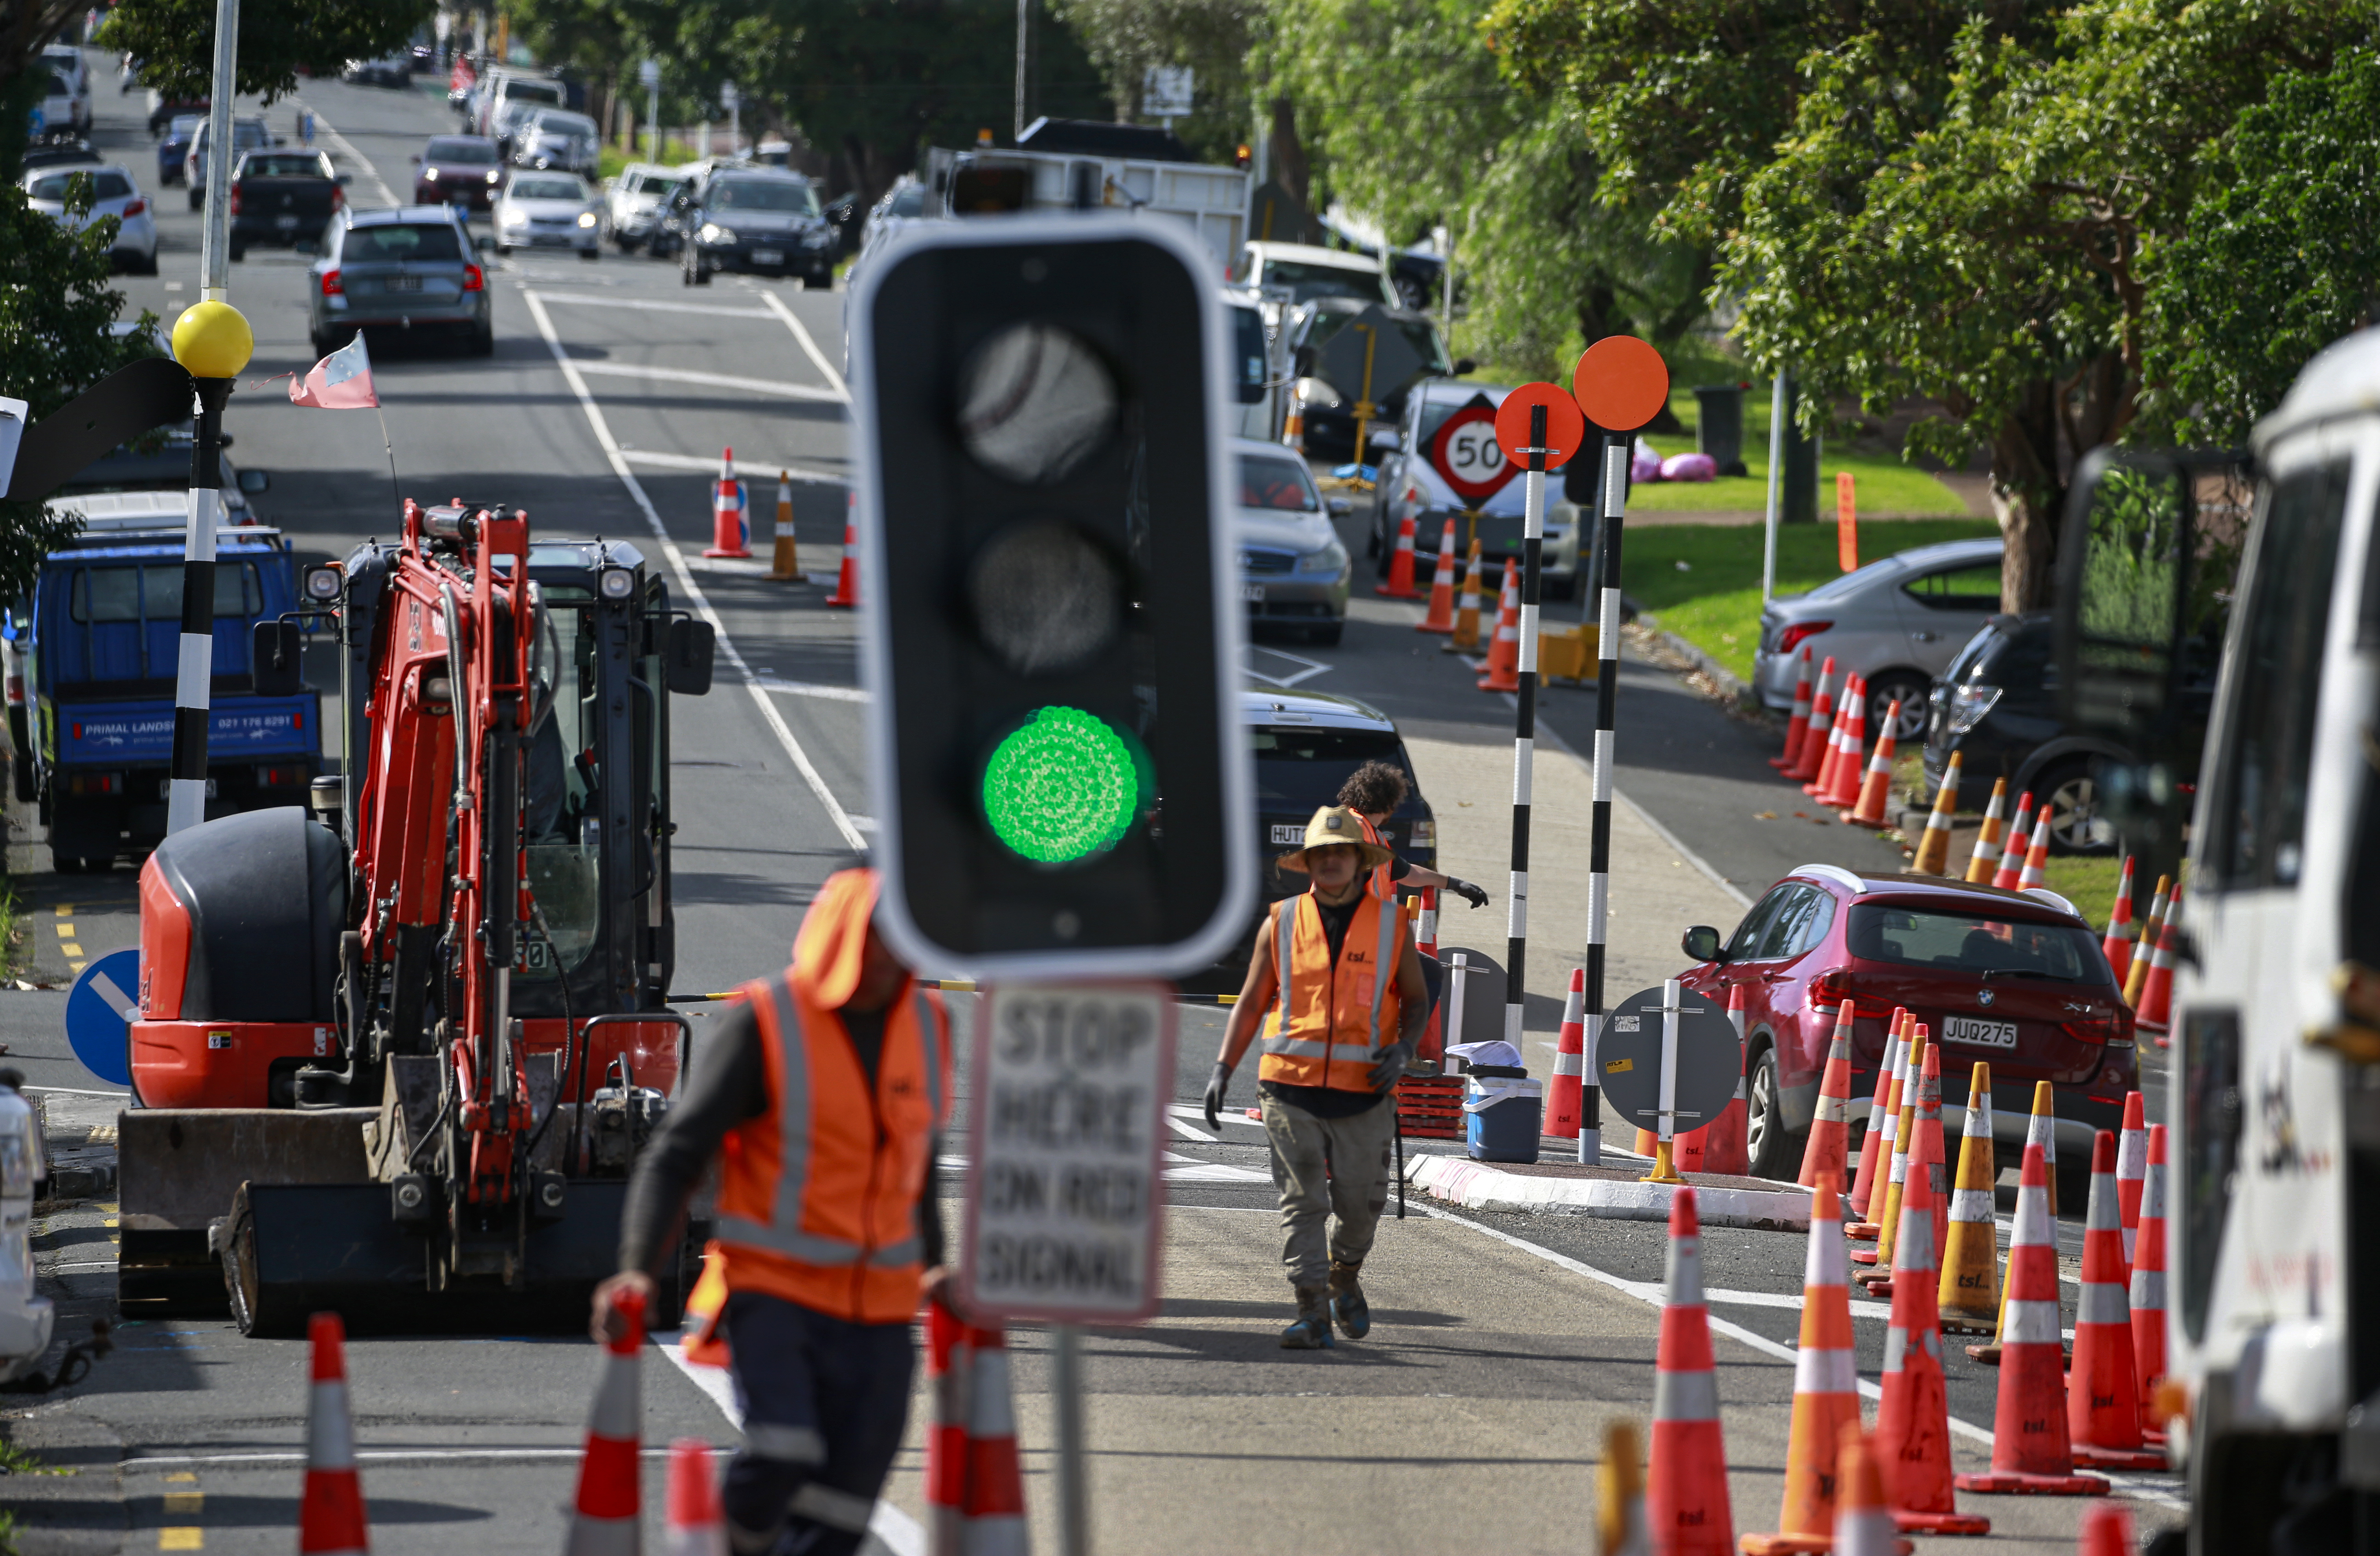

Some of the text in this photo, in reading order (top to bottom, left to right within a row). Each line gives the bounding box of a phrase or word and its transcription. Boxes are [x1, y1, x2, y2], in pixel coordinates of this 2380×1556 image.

[1455, 437, 1502, 469] 50
[86, 723, 128, 735] PRIMAL
[219, 719, 238, 729] 021
[242, 717, 262, 727] 176
[1001, 997, 1154, 1070] STOP
[1946, 1020, 2014, 1044] JUQ275
